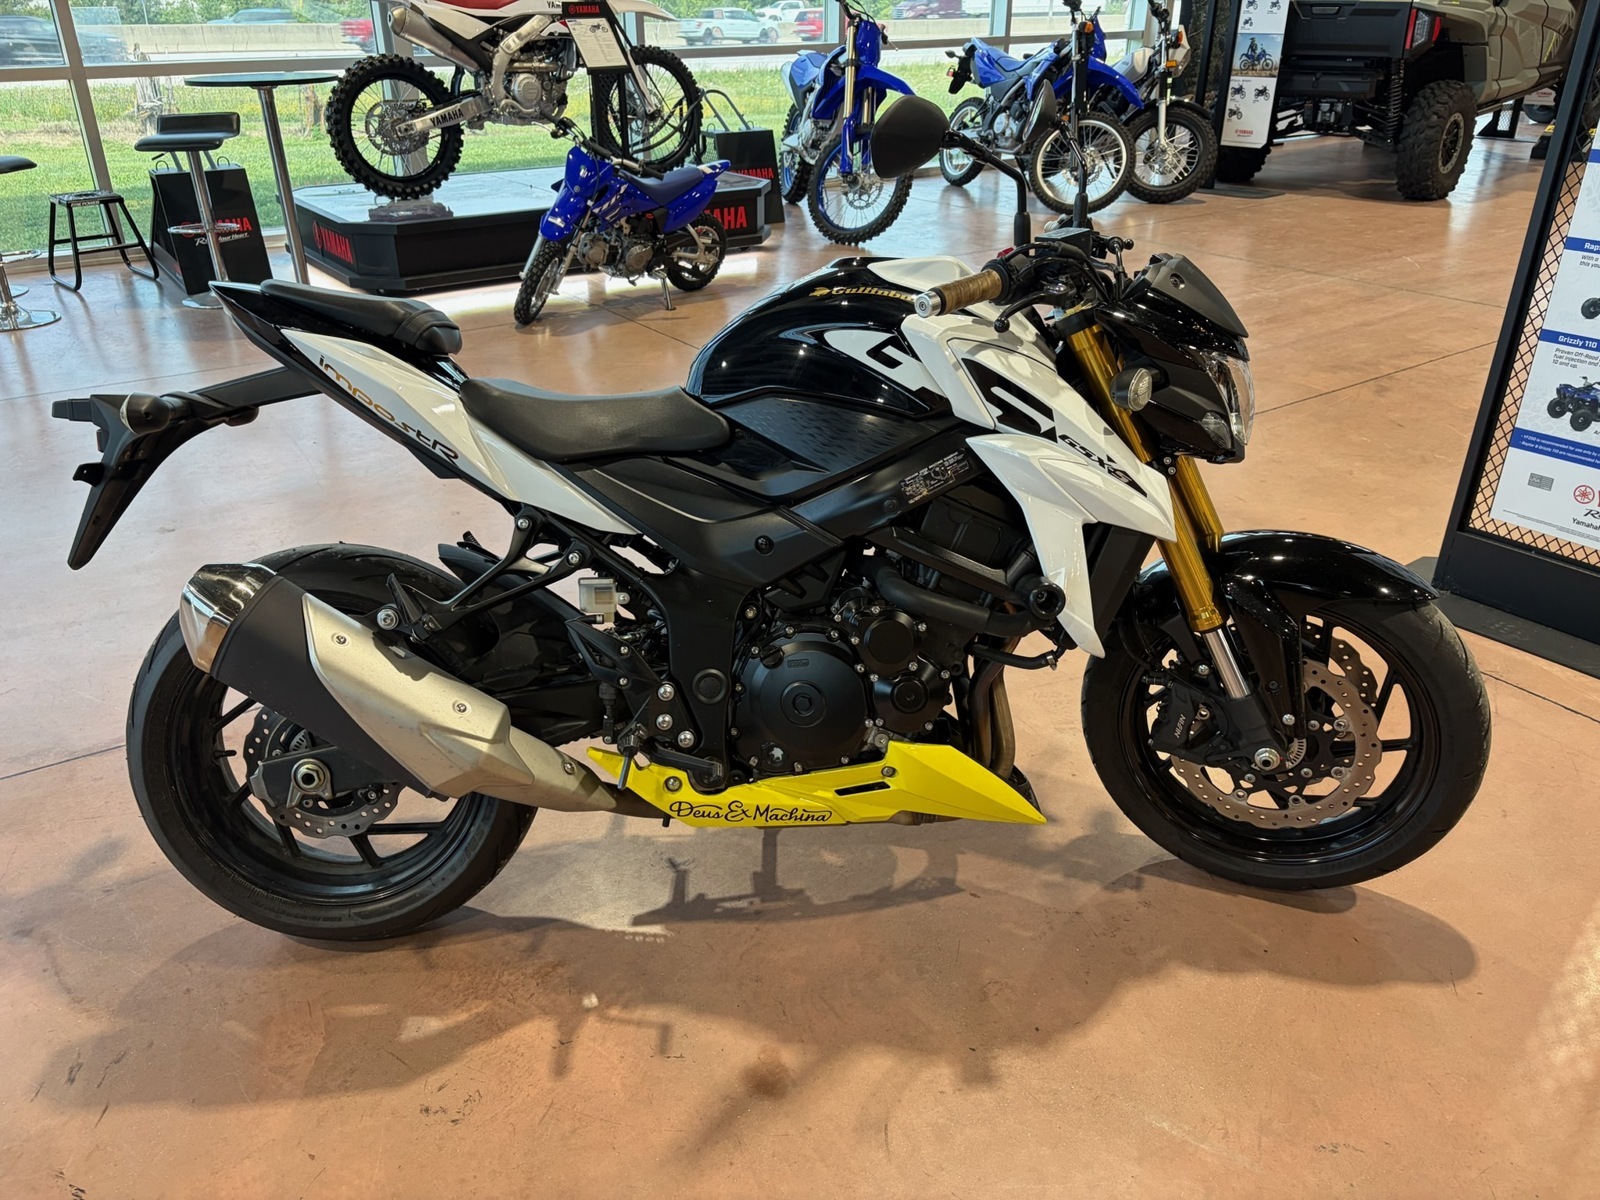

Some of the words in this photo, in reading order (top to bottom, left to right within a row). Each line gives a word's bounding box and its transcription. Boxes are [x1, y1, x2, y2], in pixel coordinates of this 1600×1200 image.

[576, 5, 600, 13] YAMAHA
[430, 108, 464, 126] YAMAHA
[320, 226, 353, 264] YAMAHA
[1584, 242, 1600, 251] Rap
[1558, 335, 1583, 347] Grizzly
[1585, 340, 1598, 348] 110
[1555, 347, 1574, 356] Proven
[1574, 351, 1599, 361] Off-Road
[1564, 355, 1587, 365] injection
[1540, 439, 1569, 449] recommended
[1058, 434, 1133, 484] GSX-S
[669, 801, 723, 819] Deus
[724, 800, 752, 822] Ex
[753, 804, 833, 823] Machina
